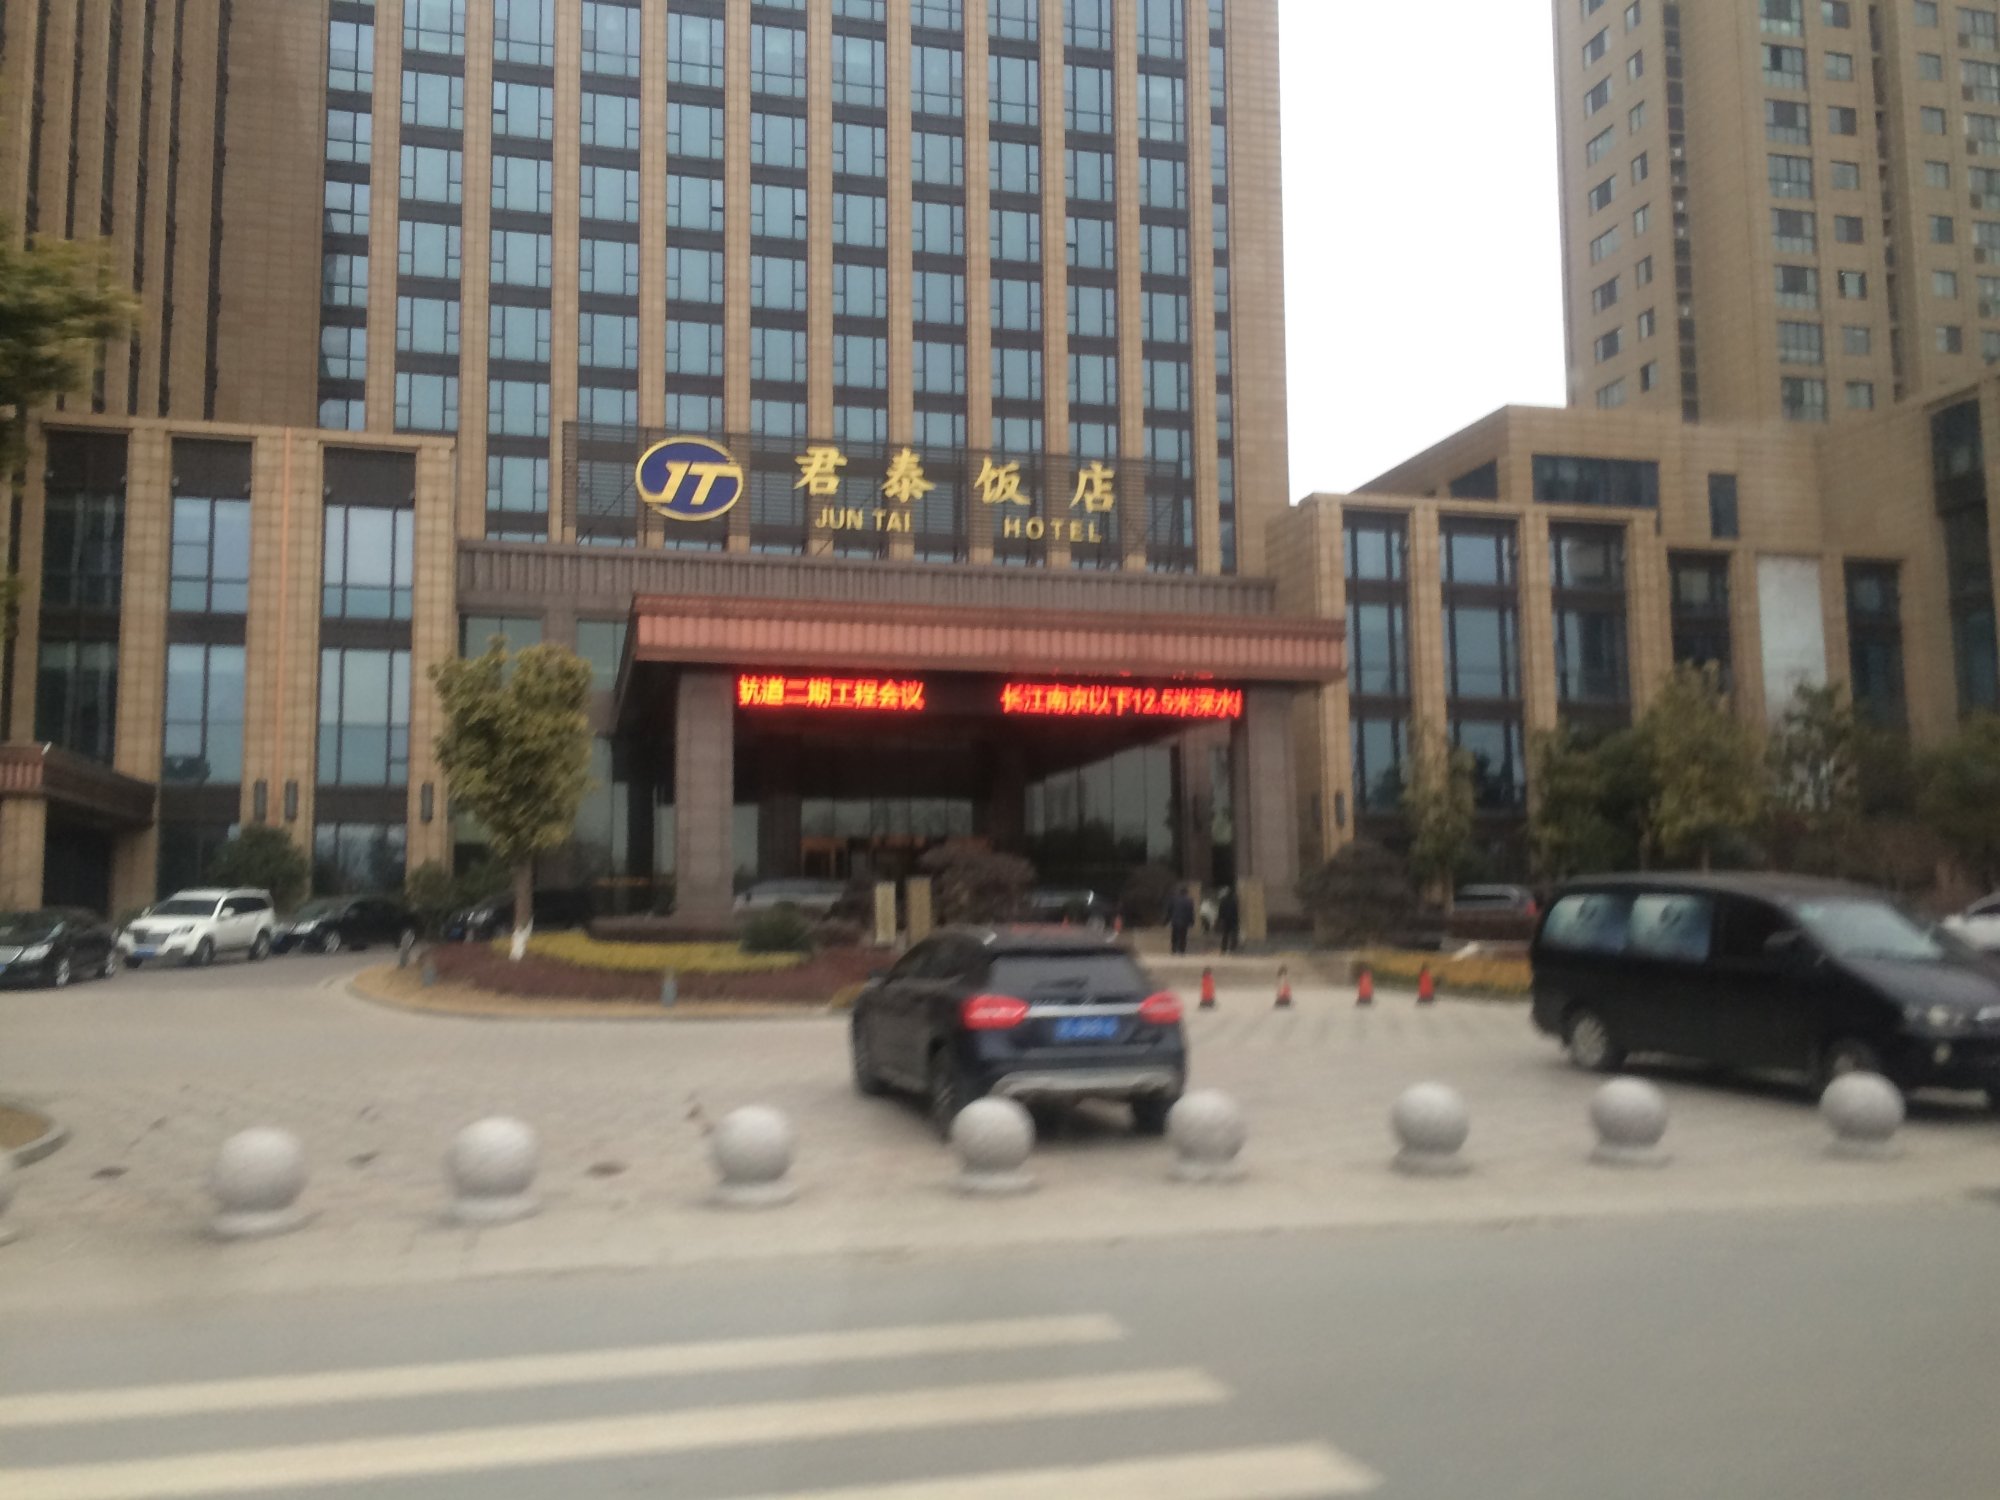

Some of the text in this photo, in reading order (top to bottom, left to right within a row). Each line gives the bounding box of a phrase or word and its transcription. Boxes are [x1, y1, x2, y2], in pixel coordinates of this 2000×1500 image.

[794, 446, 1117, 513] 君泰饭店
[815, 508, 1102, 543] JUN TAI HOTEL
[1000, 683, 1242, 718] 长江南京以下12.5米深水
